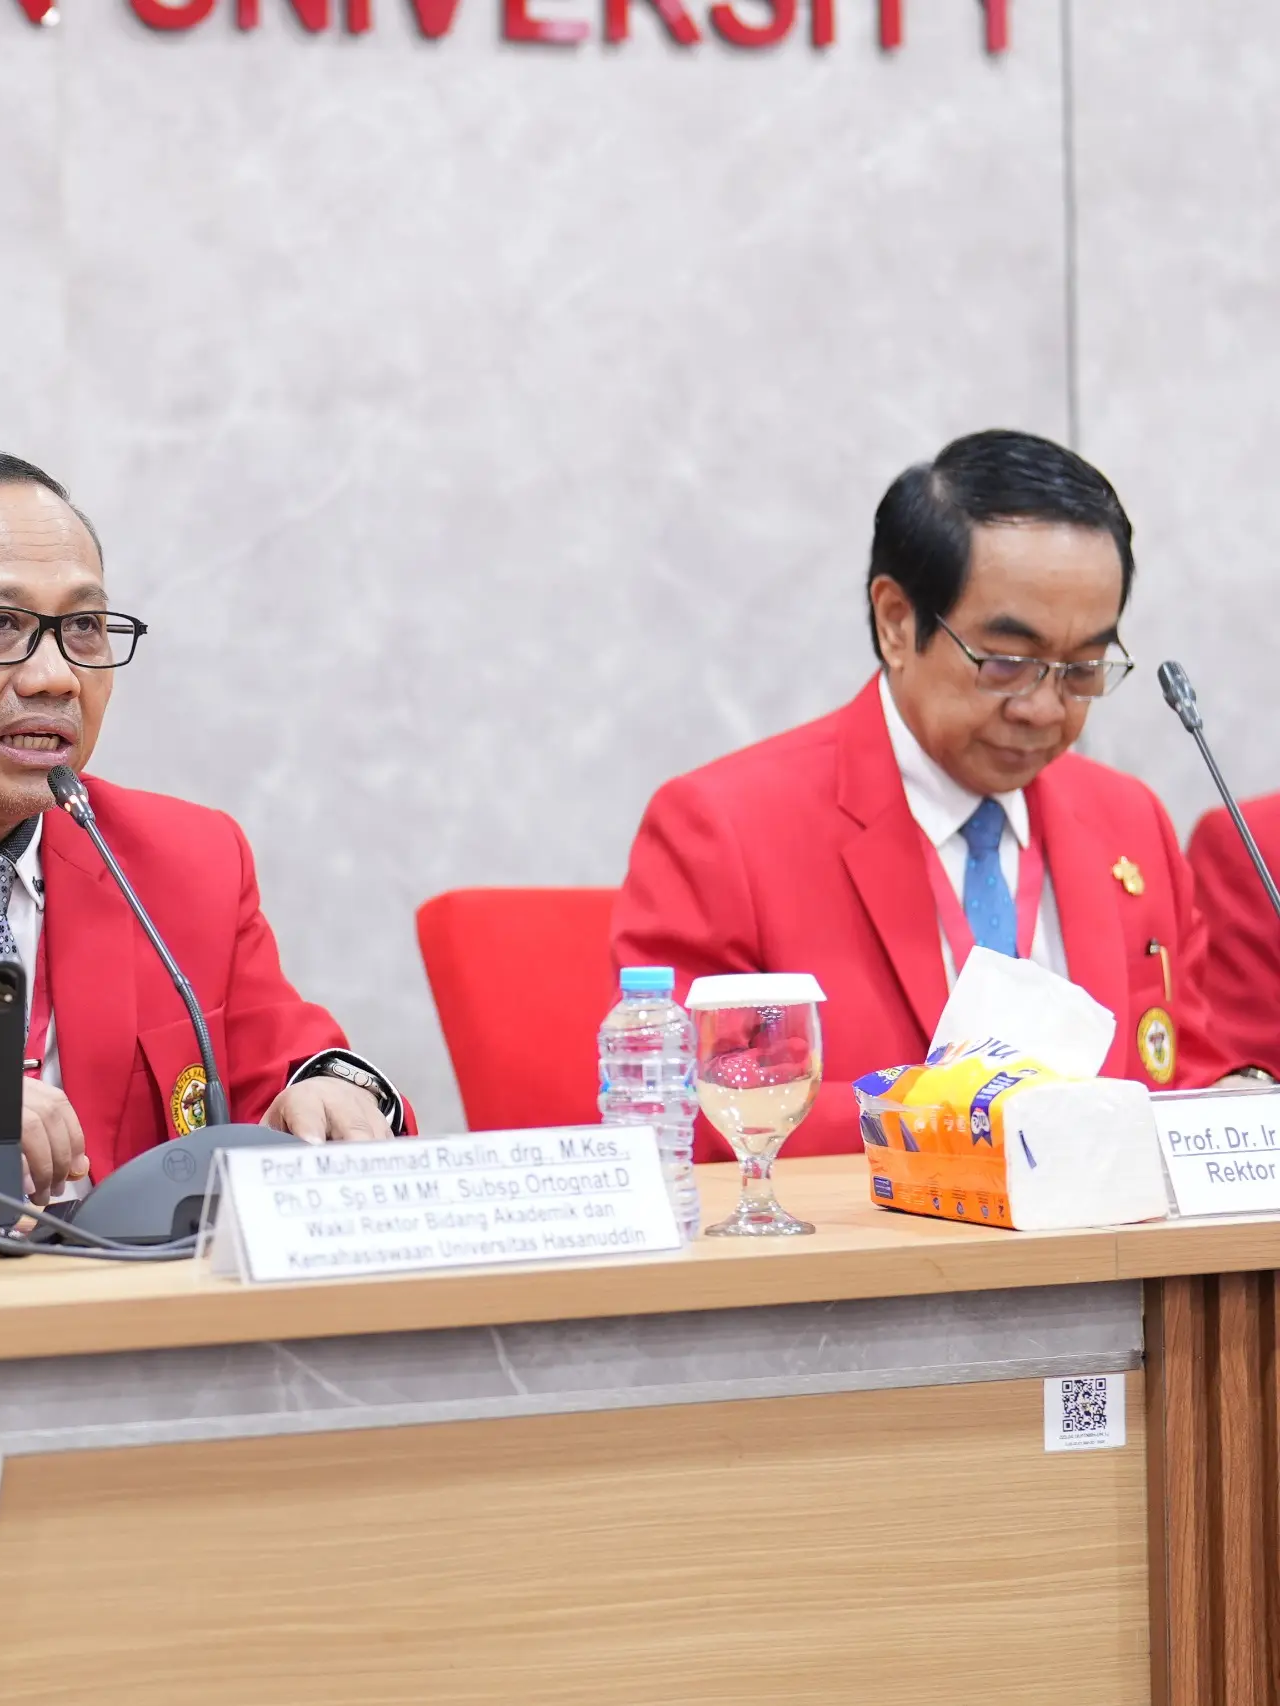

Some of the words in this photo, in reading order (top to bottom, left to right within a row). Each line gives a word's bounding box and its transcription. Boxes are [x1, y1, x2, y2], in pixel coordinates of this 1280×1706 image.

[1168, 1128, 1220, 1152] Prof.
[1224, 1127, 1256, 1149] Dr.
[316, 1148, 430, 1174] Muhammad
[1205, 1160, 1276, 1183] Rektor
[305, 1217, 355, 1238] Wakil
[360, 1215, 419, 1235] Rektor
[424, 1209, 489, 1232] Bidang
[494, 1203, 579, 1225] Akademik
[583, 1201, 616, 1219] dan
[286, 1243, 434, 1270] Kemahasiswaan
[438, 1236, 538, 1258] Universitas
[542, 1225, 647, 1251] Hasanuddin
